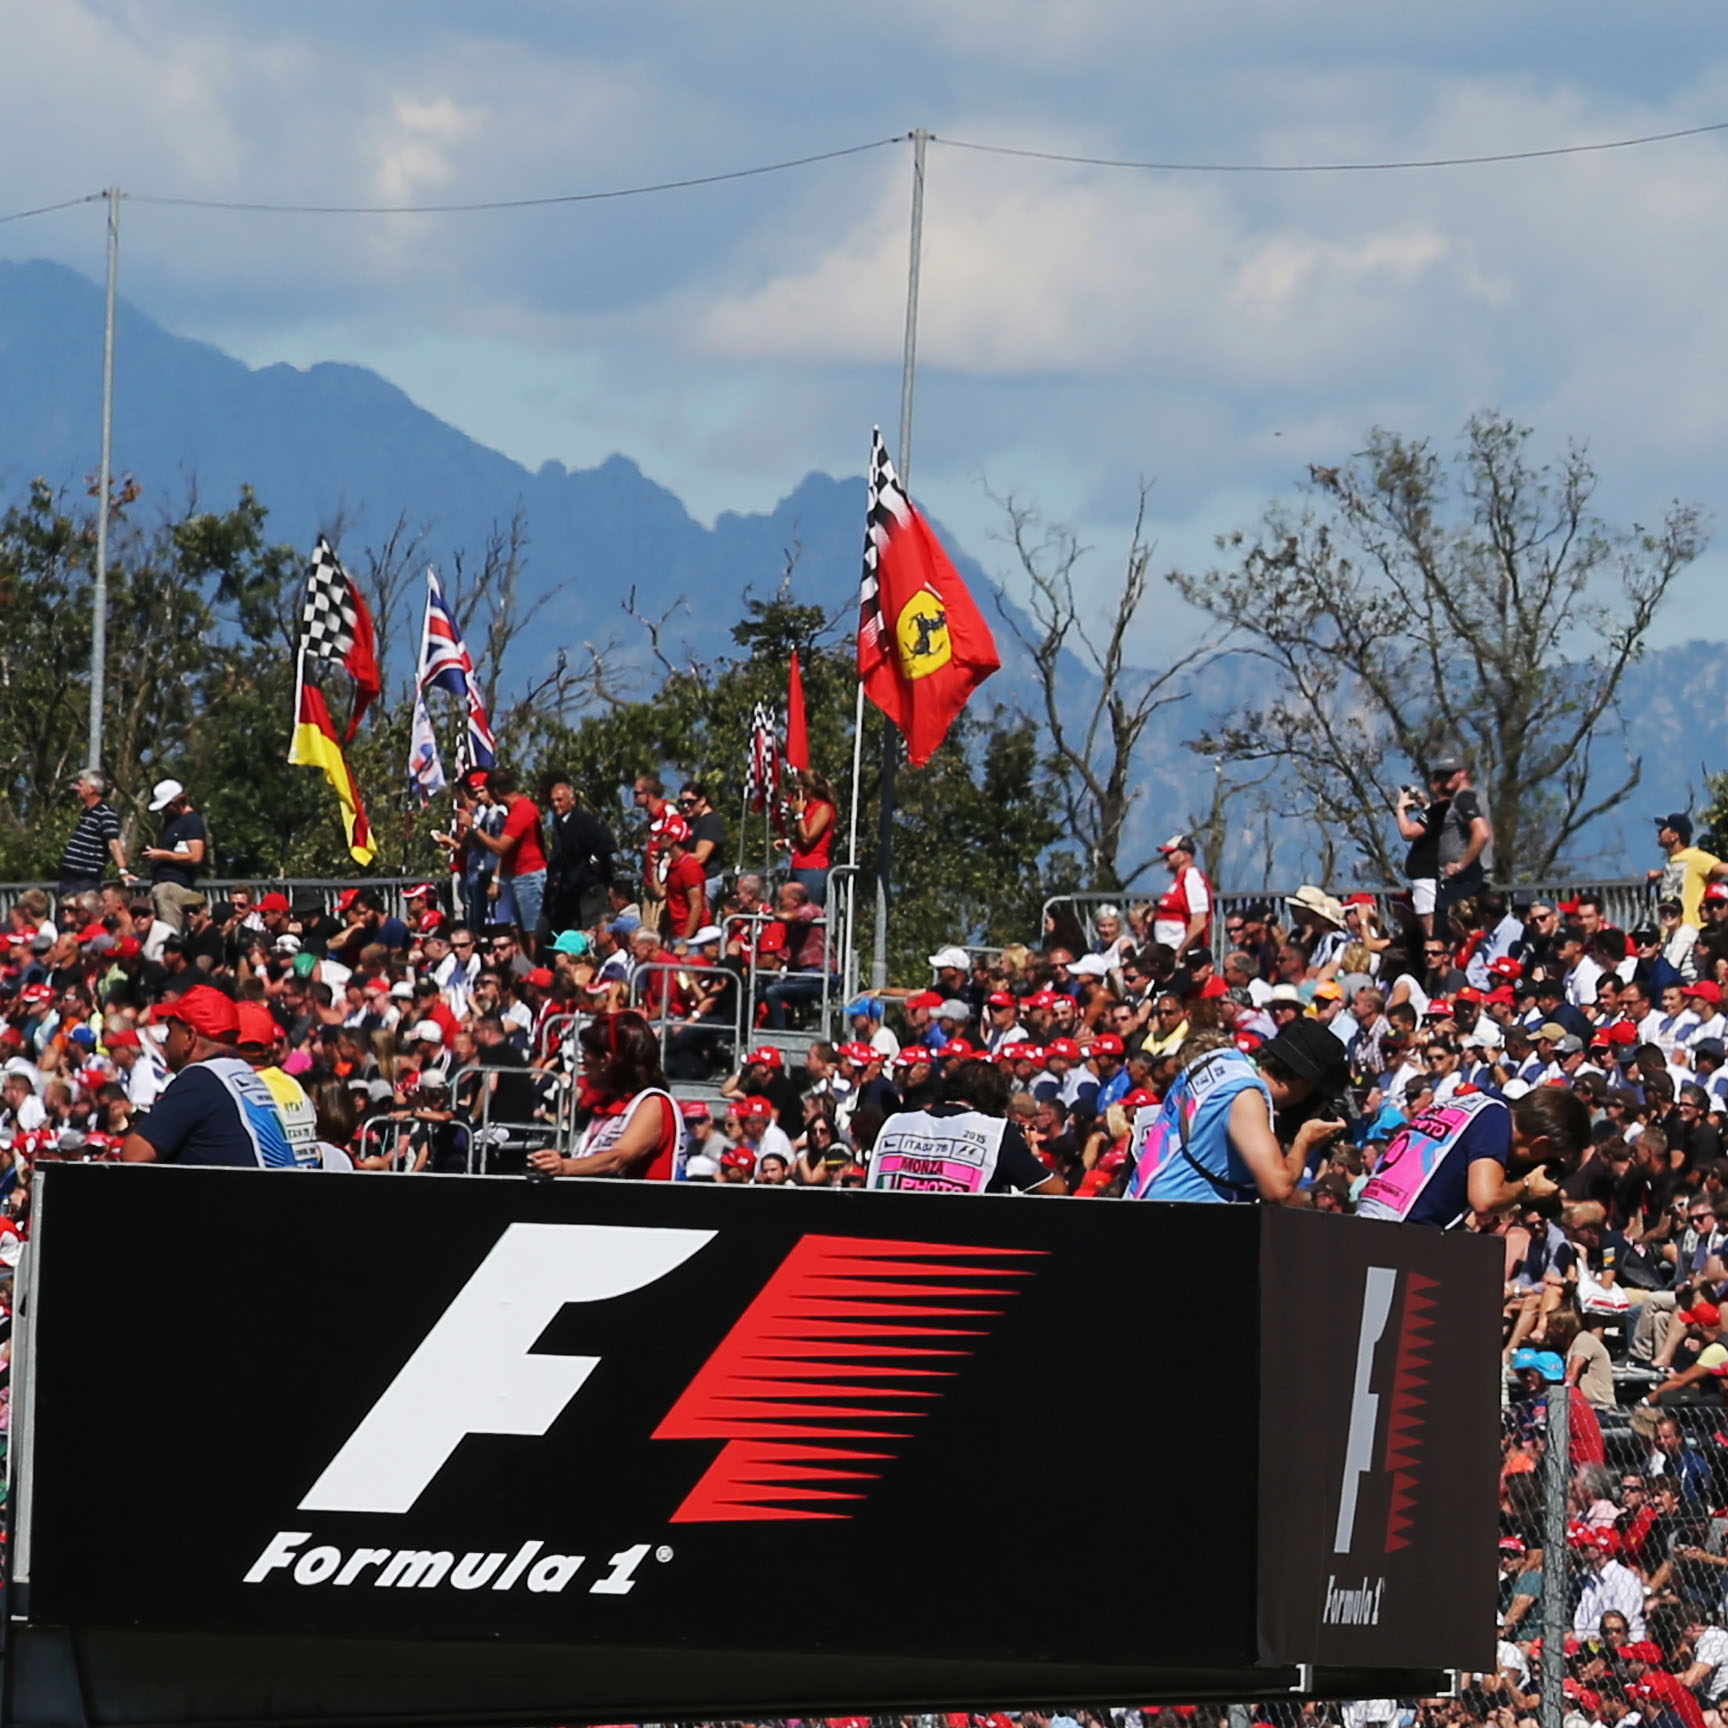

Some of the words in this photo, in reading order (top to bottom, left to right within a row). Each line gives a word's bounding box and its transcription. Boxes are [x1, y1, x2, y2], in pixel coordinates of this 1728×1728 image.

[901, 1156, 944, 1176] MONZA
[242, 1531, 586, 1592] Formula
[1322, 1574, 1374, 1625] Formula
